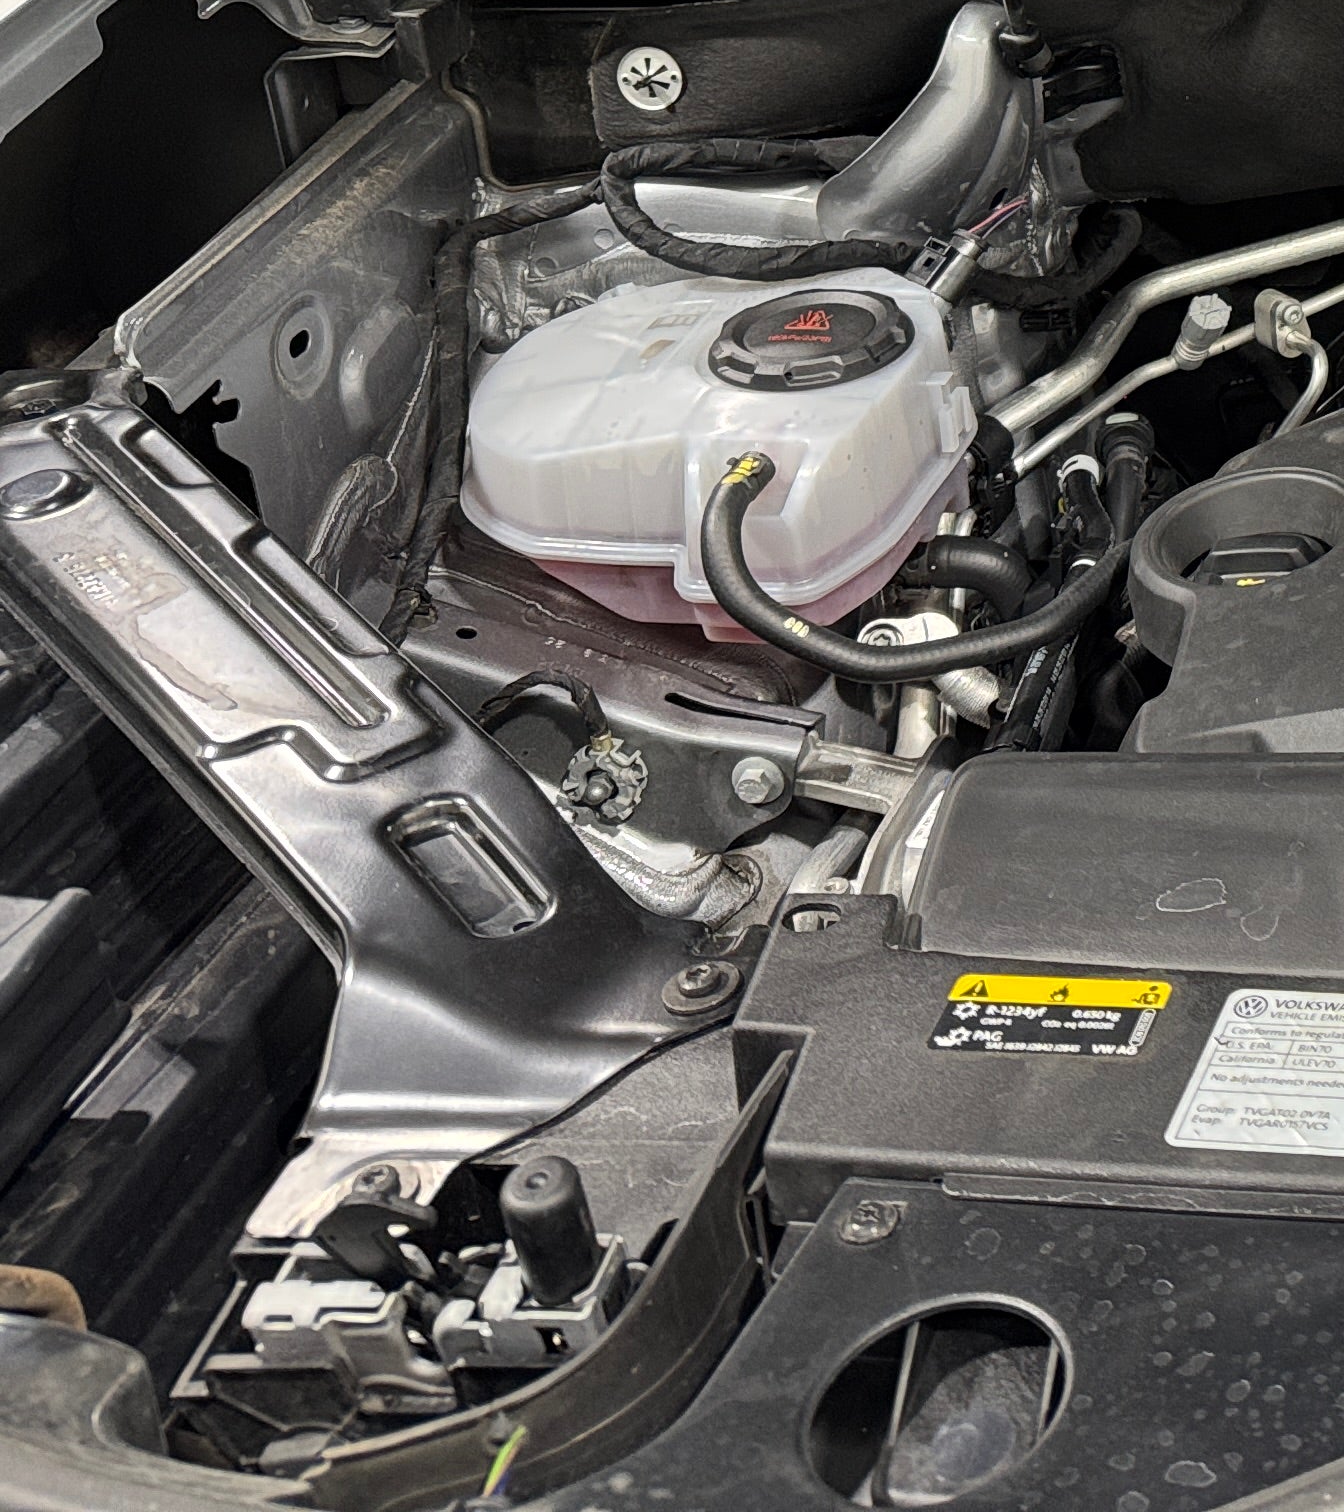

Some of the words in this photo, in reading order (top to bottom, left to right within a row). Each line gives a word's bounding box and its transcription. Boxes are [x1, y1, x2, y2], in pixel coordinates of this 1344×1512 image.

[1270, 1011, 1316, 1021] VEHICLE
[972, 1029, 1004, 1041] PAG
[1231, 1026, 1286, 1037] Conforms
[1291, 1029, 1302, 1037] to
[1091, 1044, 1116, 1054] VW
[1115, 1045, 1138, 1056] AG
[1250, 1042, 1272, 1050] EPA
[1218, 1055, 1275, 1064] California
[1210, 1073, 1228, 1082] No
[1230, 1074, 1304, 1087] adjustments
